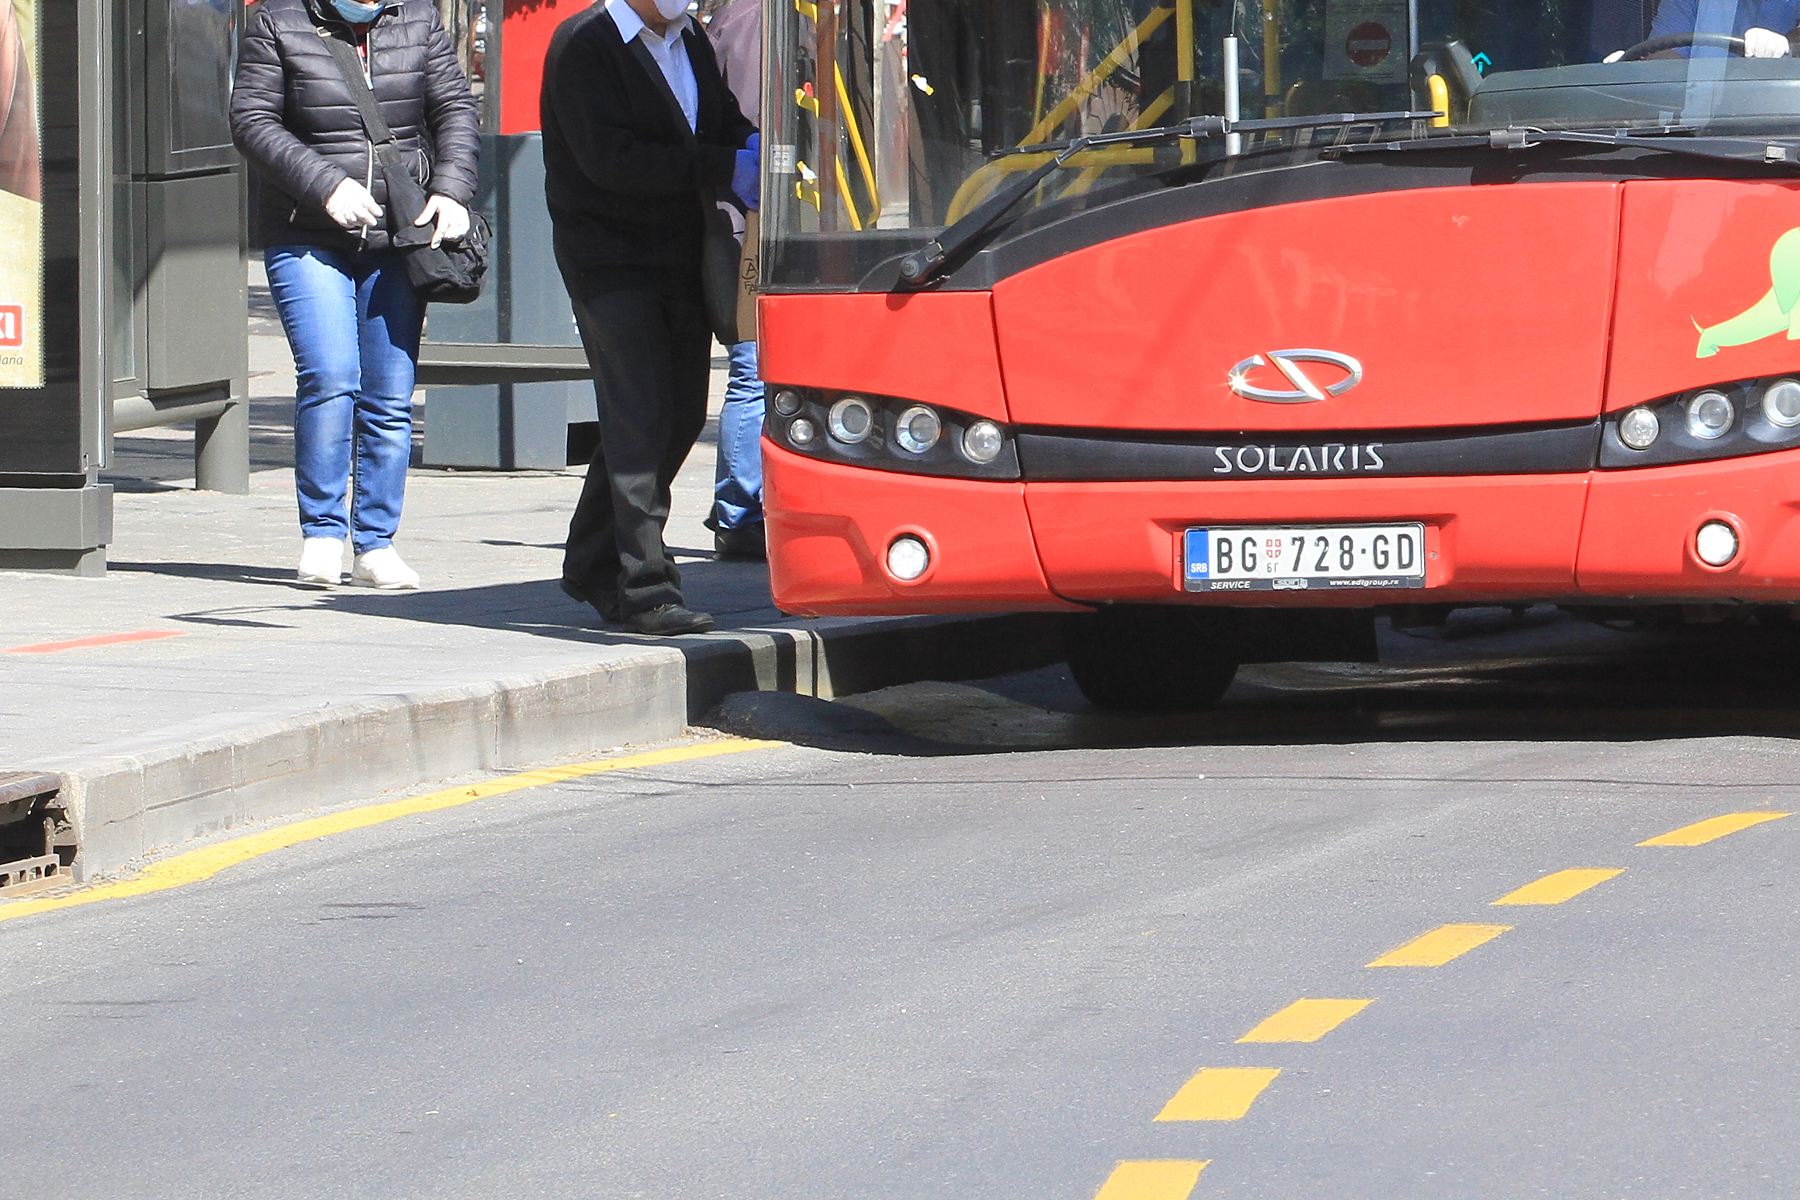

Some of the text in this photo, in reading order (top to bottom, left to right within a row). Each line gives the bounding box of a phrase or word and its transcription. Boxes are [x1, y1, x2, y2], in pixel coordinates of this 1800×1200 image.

[1213, 443, 1385, 474] SOLARIS
[1216, 536, 1258, 574] BG
[1190, 562, 1208, 574] SRB
[1266, 562, 1280, 573] БГ
[1210, 580, 1251, 590] SERVICE
